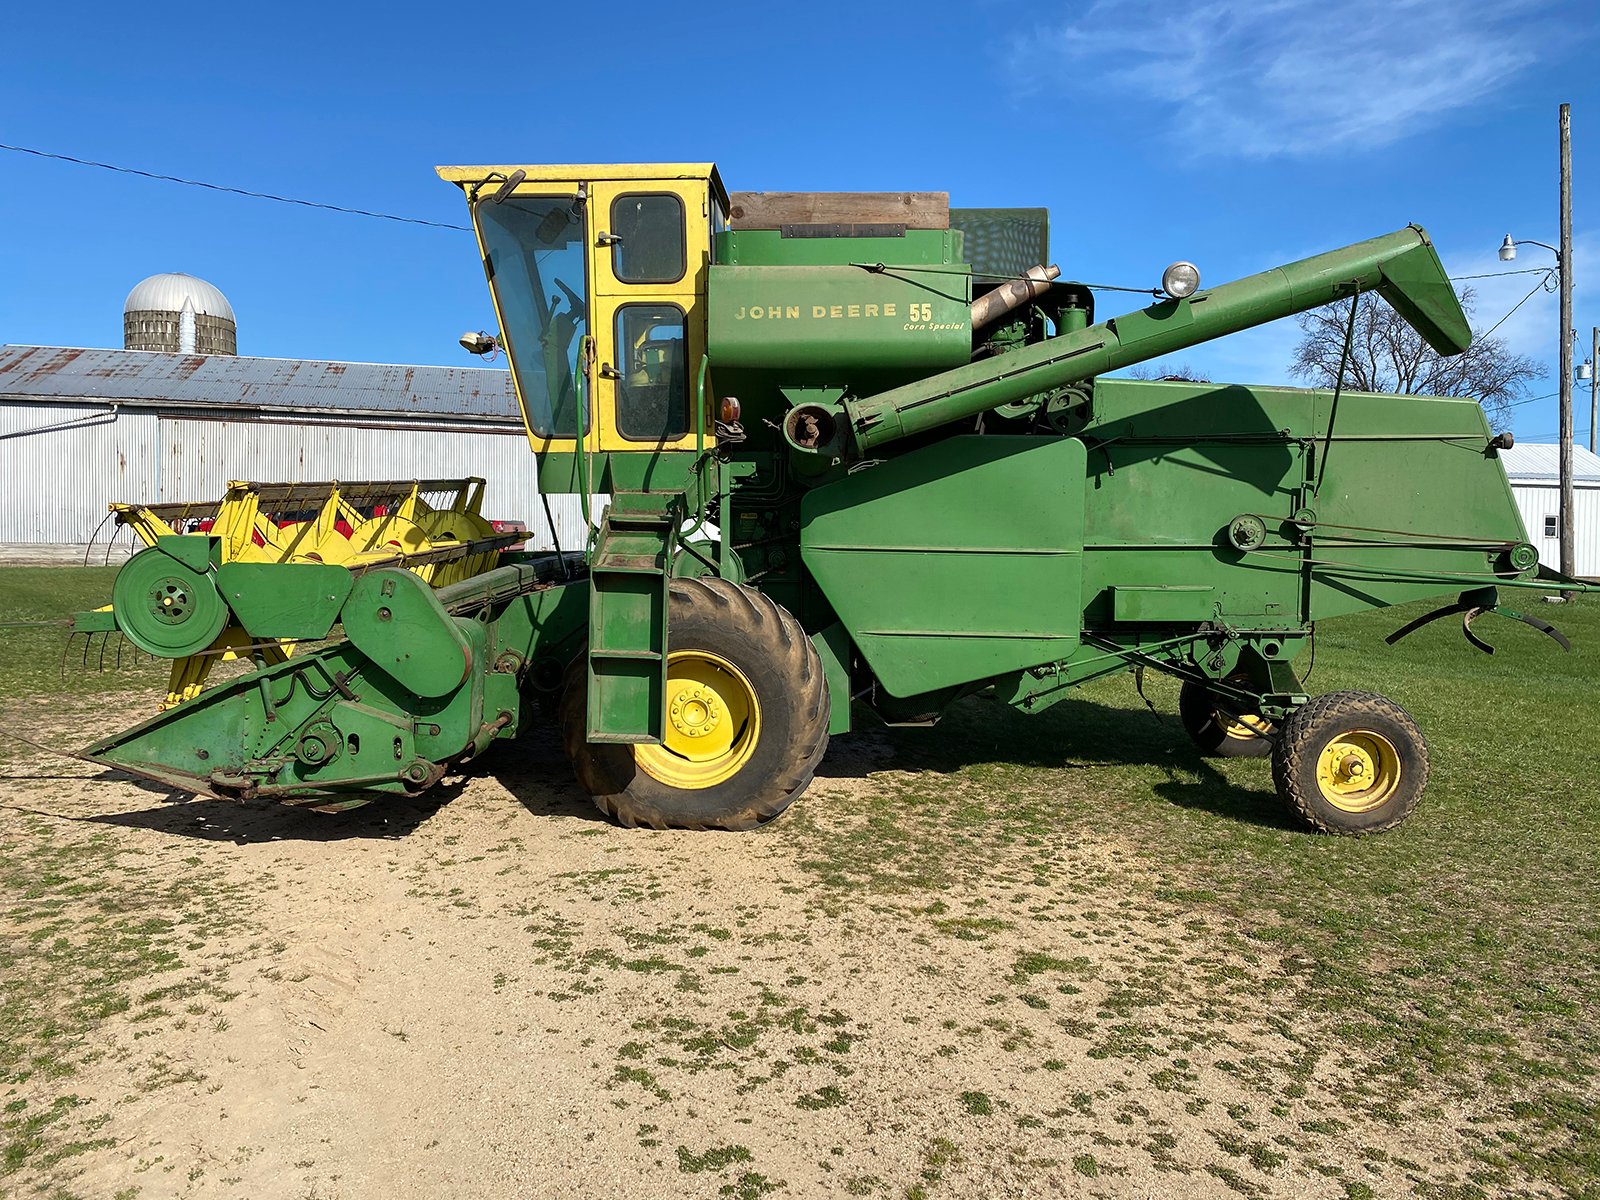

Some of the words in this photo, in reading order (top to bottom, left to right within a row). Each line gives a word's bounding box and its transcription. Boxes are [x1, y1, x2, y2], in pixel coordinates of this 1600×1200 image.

[735, 305, 800, 320] JOHN
[812, 303, 897, 318] DEERE
[909, 303, 932, 322] 55
[903, 323, 925, 331] Corn
[928, 322, 964, 331] Special
